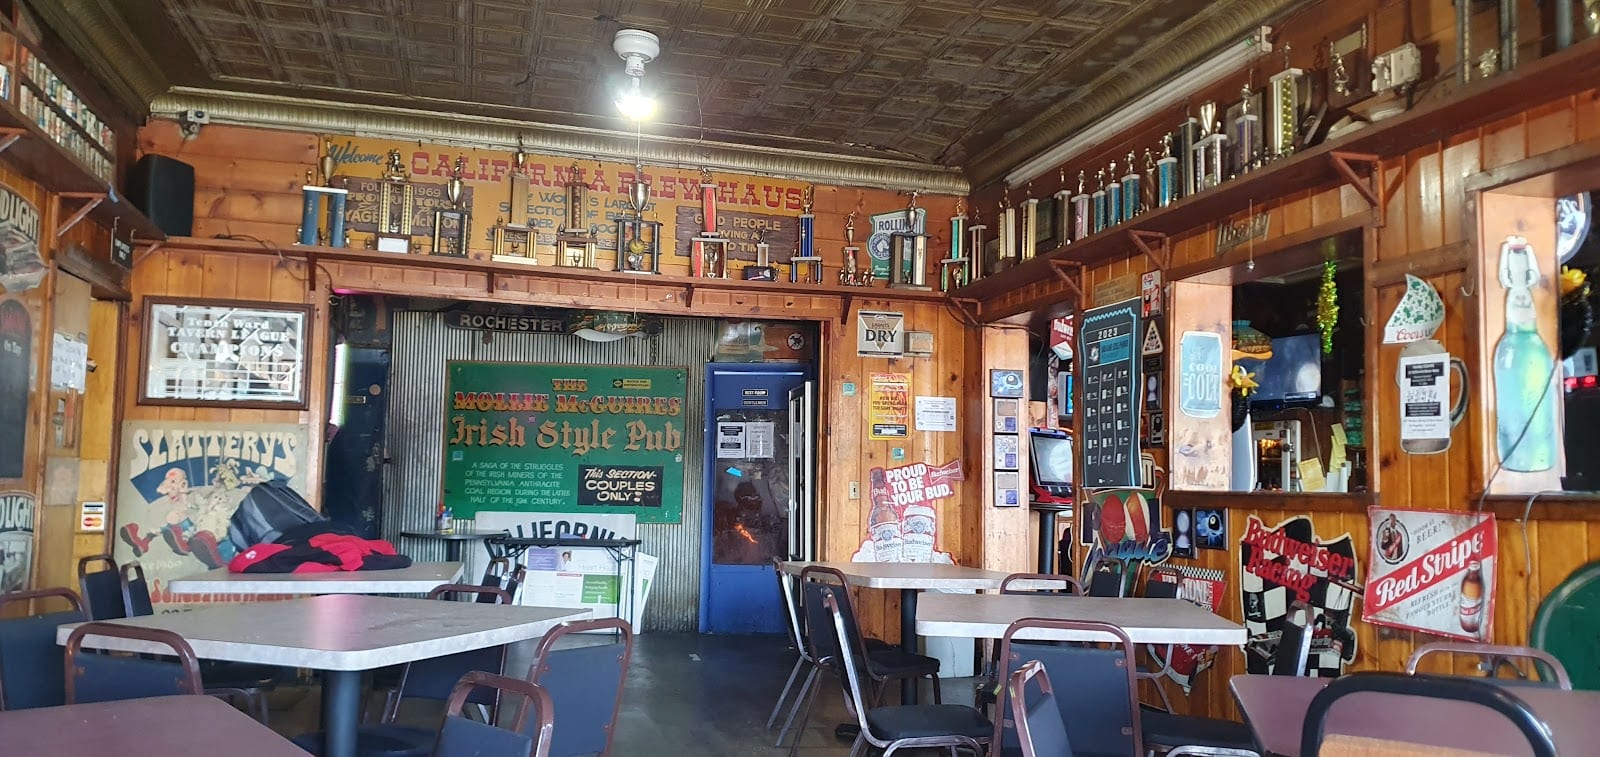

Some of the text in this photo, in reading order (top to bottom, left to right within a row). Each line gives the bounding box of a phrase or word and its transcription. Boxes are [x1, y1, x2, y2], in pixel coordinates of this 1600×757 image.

[330, 141, 383, 166] Welcome
[414, 187, 442, 198] 1969
[10, 194, 39, 240] LIGHT
[733, 216, 781, 231] PEOPLE
[187, 317, 270, 330] Tenth Ward
[459, 314, 564, 332] ROCHESTER
[167, 327, 290, 343] TAVERN LEAGUE
[865, 329, 897, 343] DRY
[1098, 327, 1118, 340] 2023
[170, 341, 285, 358] CHAMPIONS
[552, 378, 588, 393] THE
[1189, 373, 1219, 401] COLT
[453, 391, 682, 416] MOLLIE McGUIRES
[450, 416, 526, 447] Irish
[536, 418, 617, 457] Style
[624, 418, 682, 452] Pub
[130, 428, 297, 481] SLATTERY'S
[488, 470, 505, 478] IRISH
[508, 471, 535, 479] MINERS
[510, 462, 521, 470] THE
[524, 463, 564, 471] STRUGGLES
[584, 467, 603, 480] This
[886, 463, 927, 483] PROUD
[464, 487, 485, 495] COAL
[487, 488, 512, 496] REGION
[515, 489, 539, 497] DURING
[540, 489, 551, 497] THE
[465, 479, 561, 488] PENNSYLVANIA ANTHRACITE
[585, 480, 655, 492] COUPLES
[891, 476, 925, 494] TO BE
[891, 483, 954, 507] YOUR BUD.
[1244, 518, 1355, 577] Budweiser
[1246, 546, 1318, 603] Racing
[1375, 530, 1485, 607] Red Stripe
